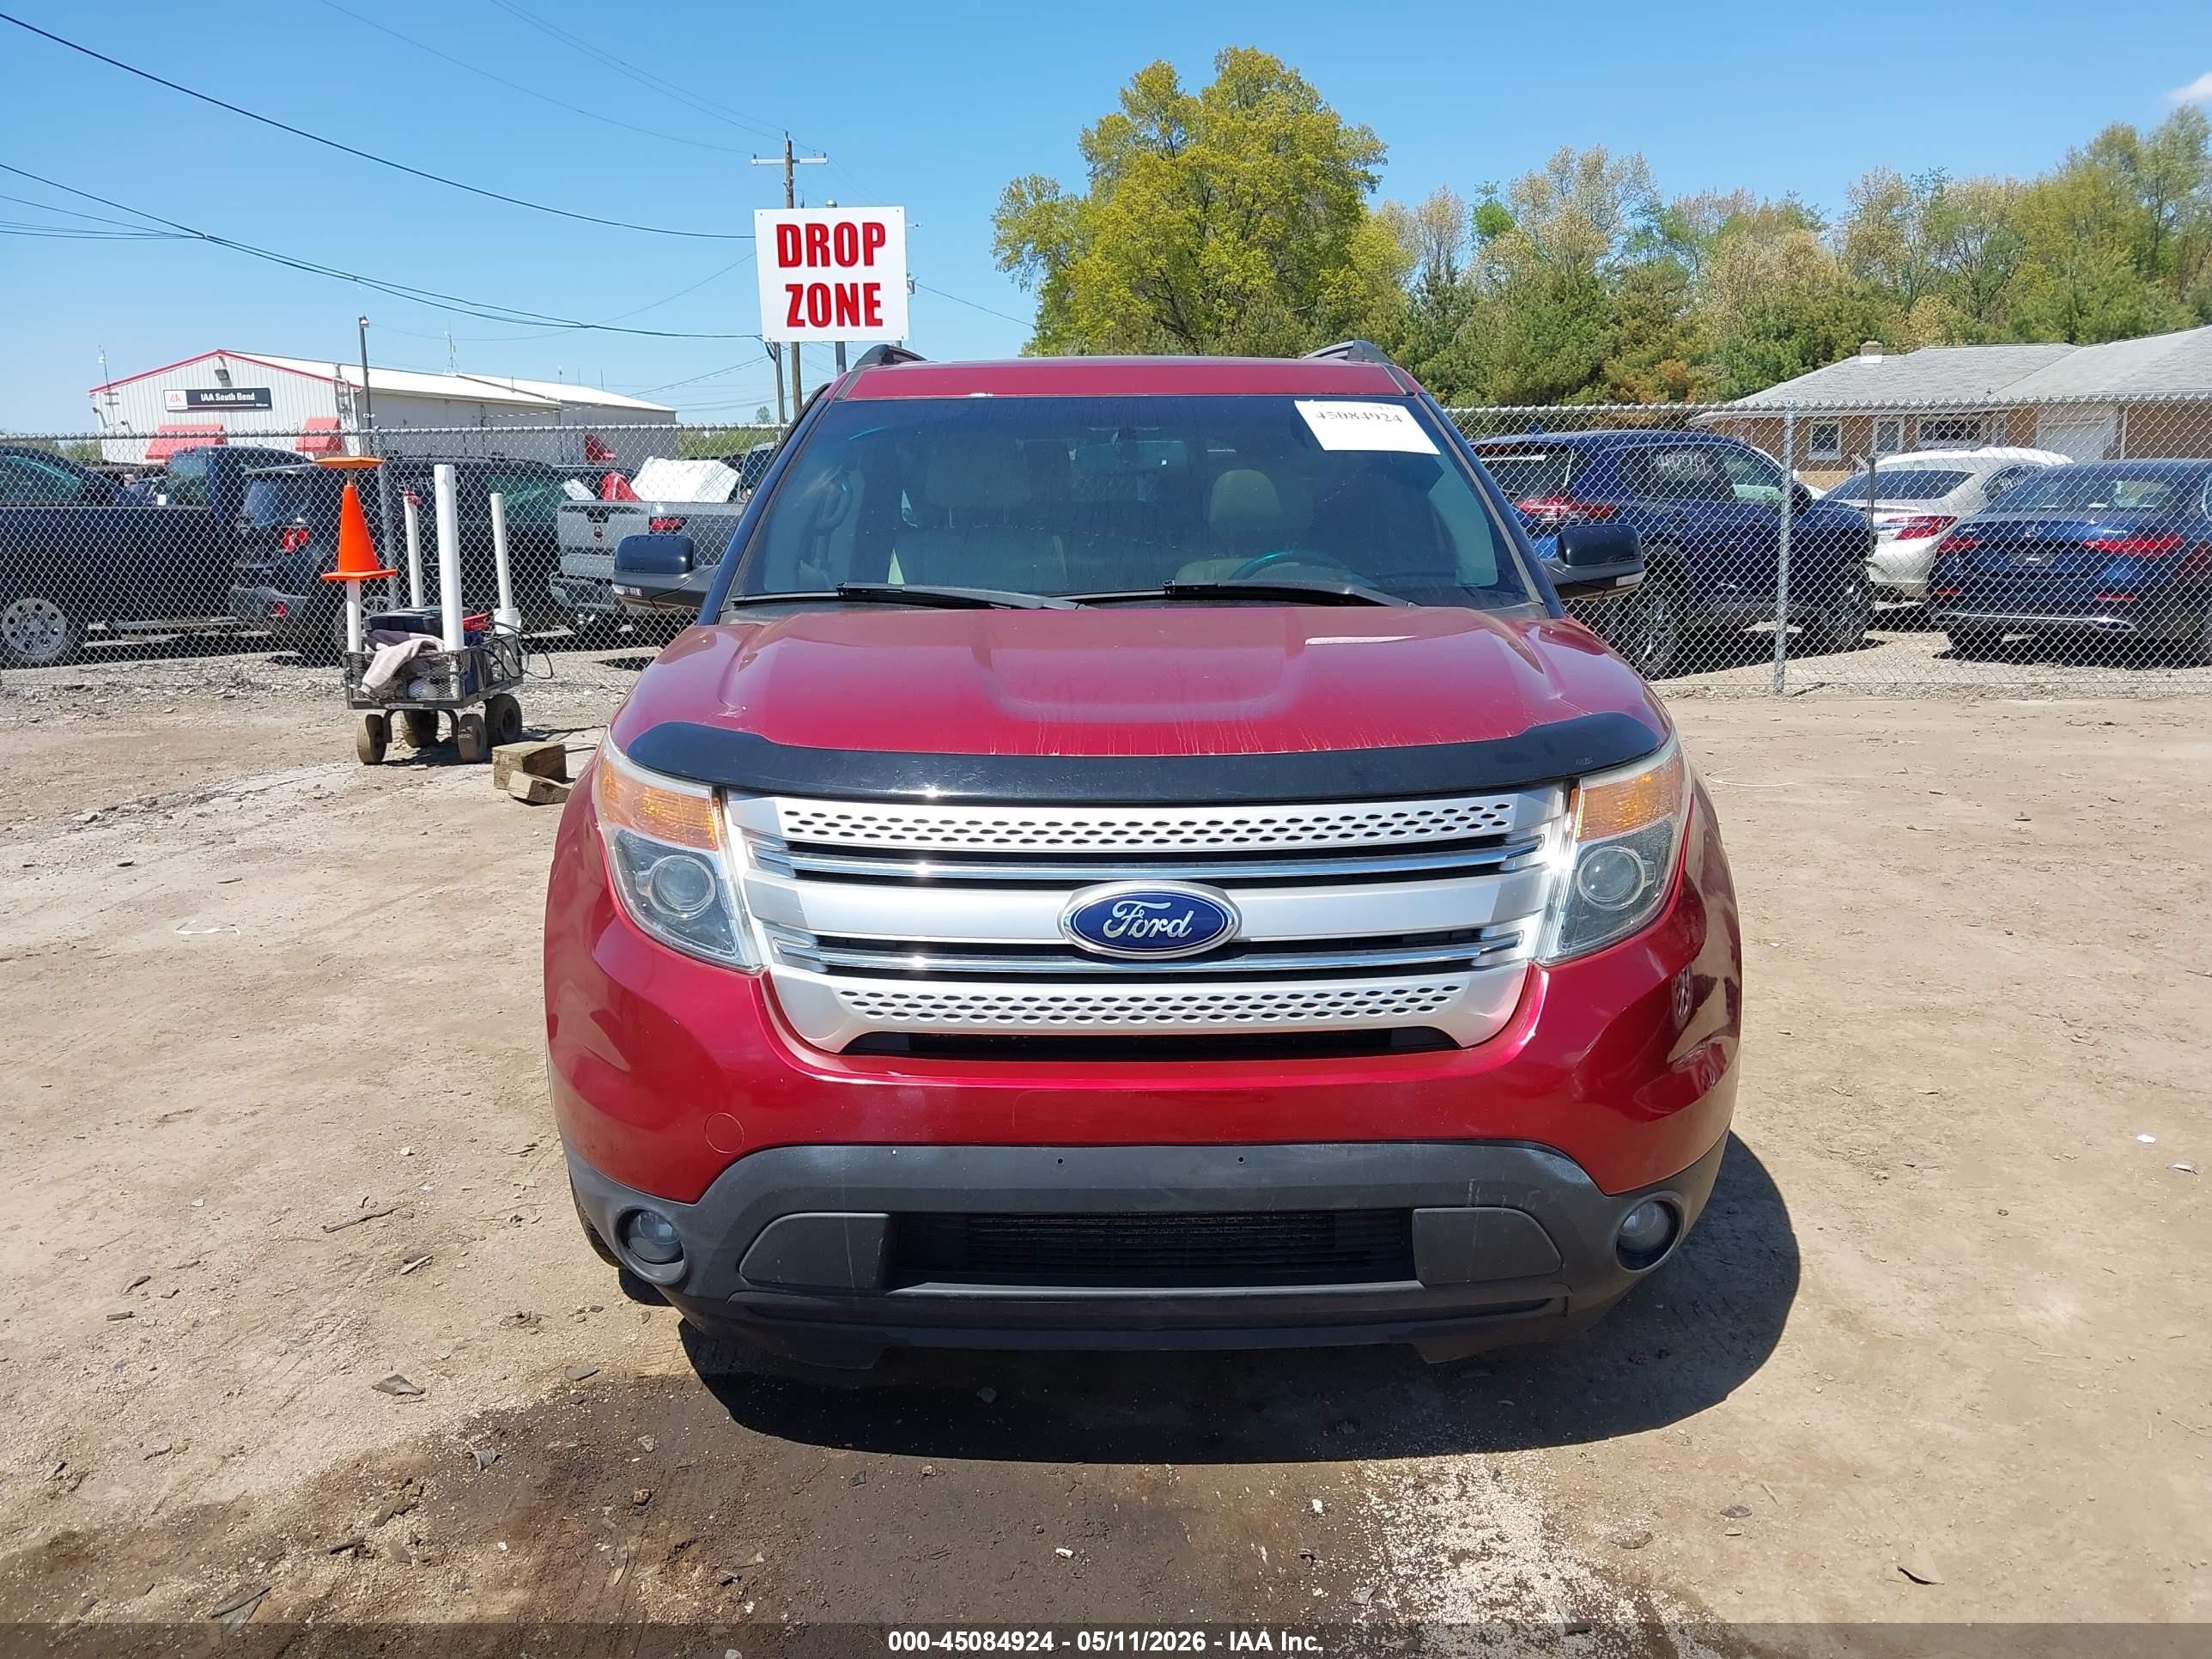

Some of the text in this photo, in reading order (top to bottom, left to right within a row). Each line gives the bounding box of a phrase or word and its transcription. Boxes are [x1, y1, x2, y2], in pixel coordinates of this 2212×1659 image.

[776, 222, 886, 268] DROP
[785, 282, 884, 328] ZONE
[216, 392, 236, 401] South
[237, 392, 255, 401] Bend
[1316, 410, 1402, 422] 45084924
[1103, 900, 1194, 939] Ford
